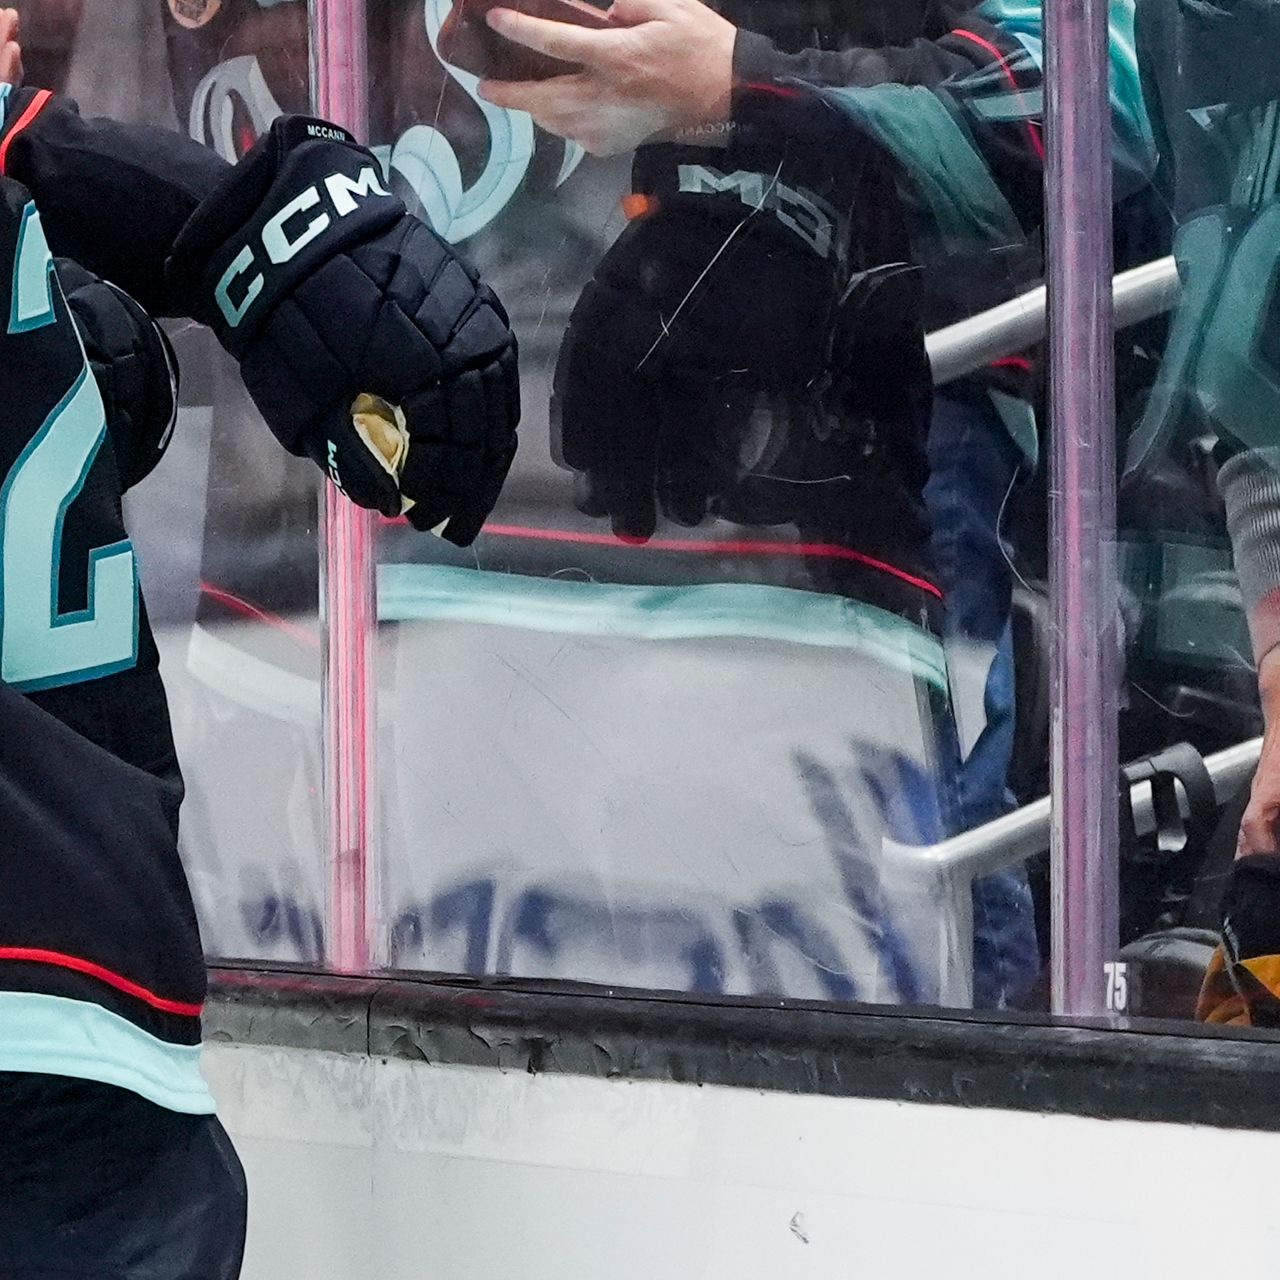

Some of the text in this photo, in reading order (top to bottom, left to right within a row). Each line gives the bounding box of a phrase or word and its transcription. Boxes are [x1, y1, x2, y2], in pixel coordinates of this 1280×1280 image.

[307, 125, 346, 141] MCCANN
[214, 167, 393, 328] CCM
[1103, 962, 1127, 1011] 75
